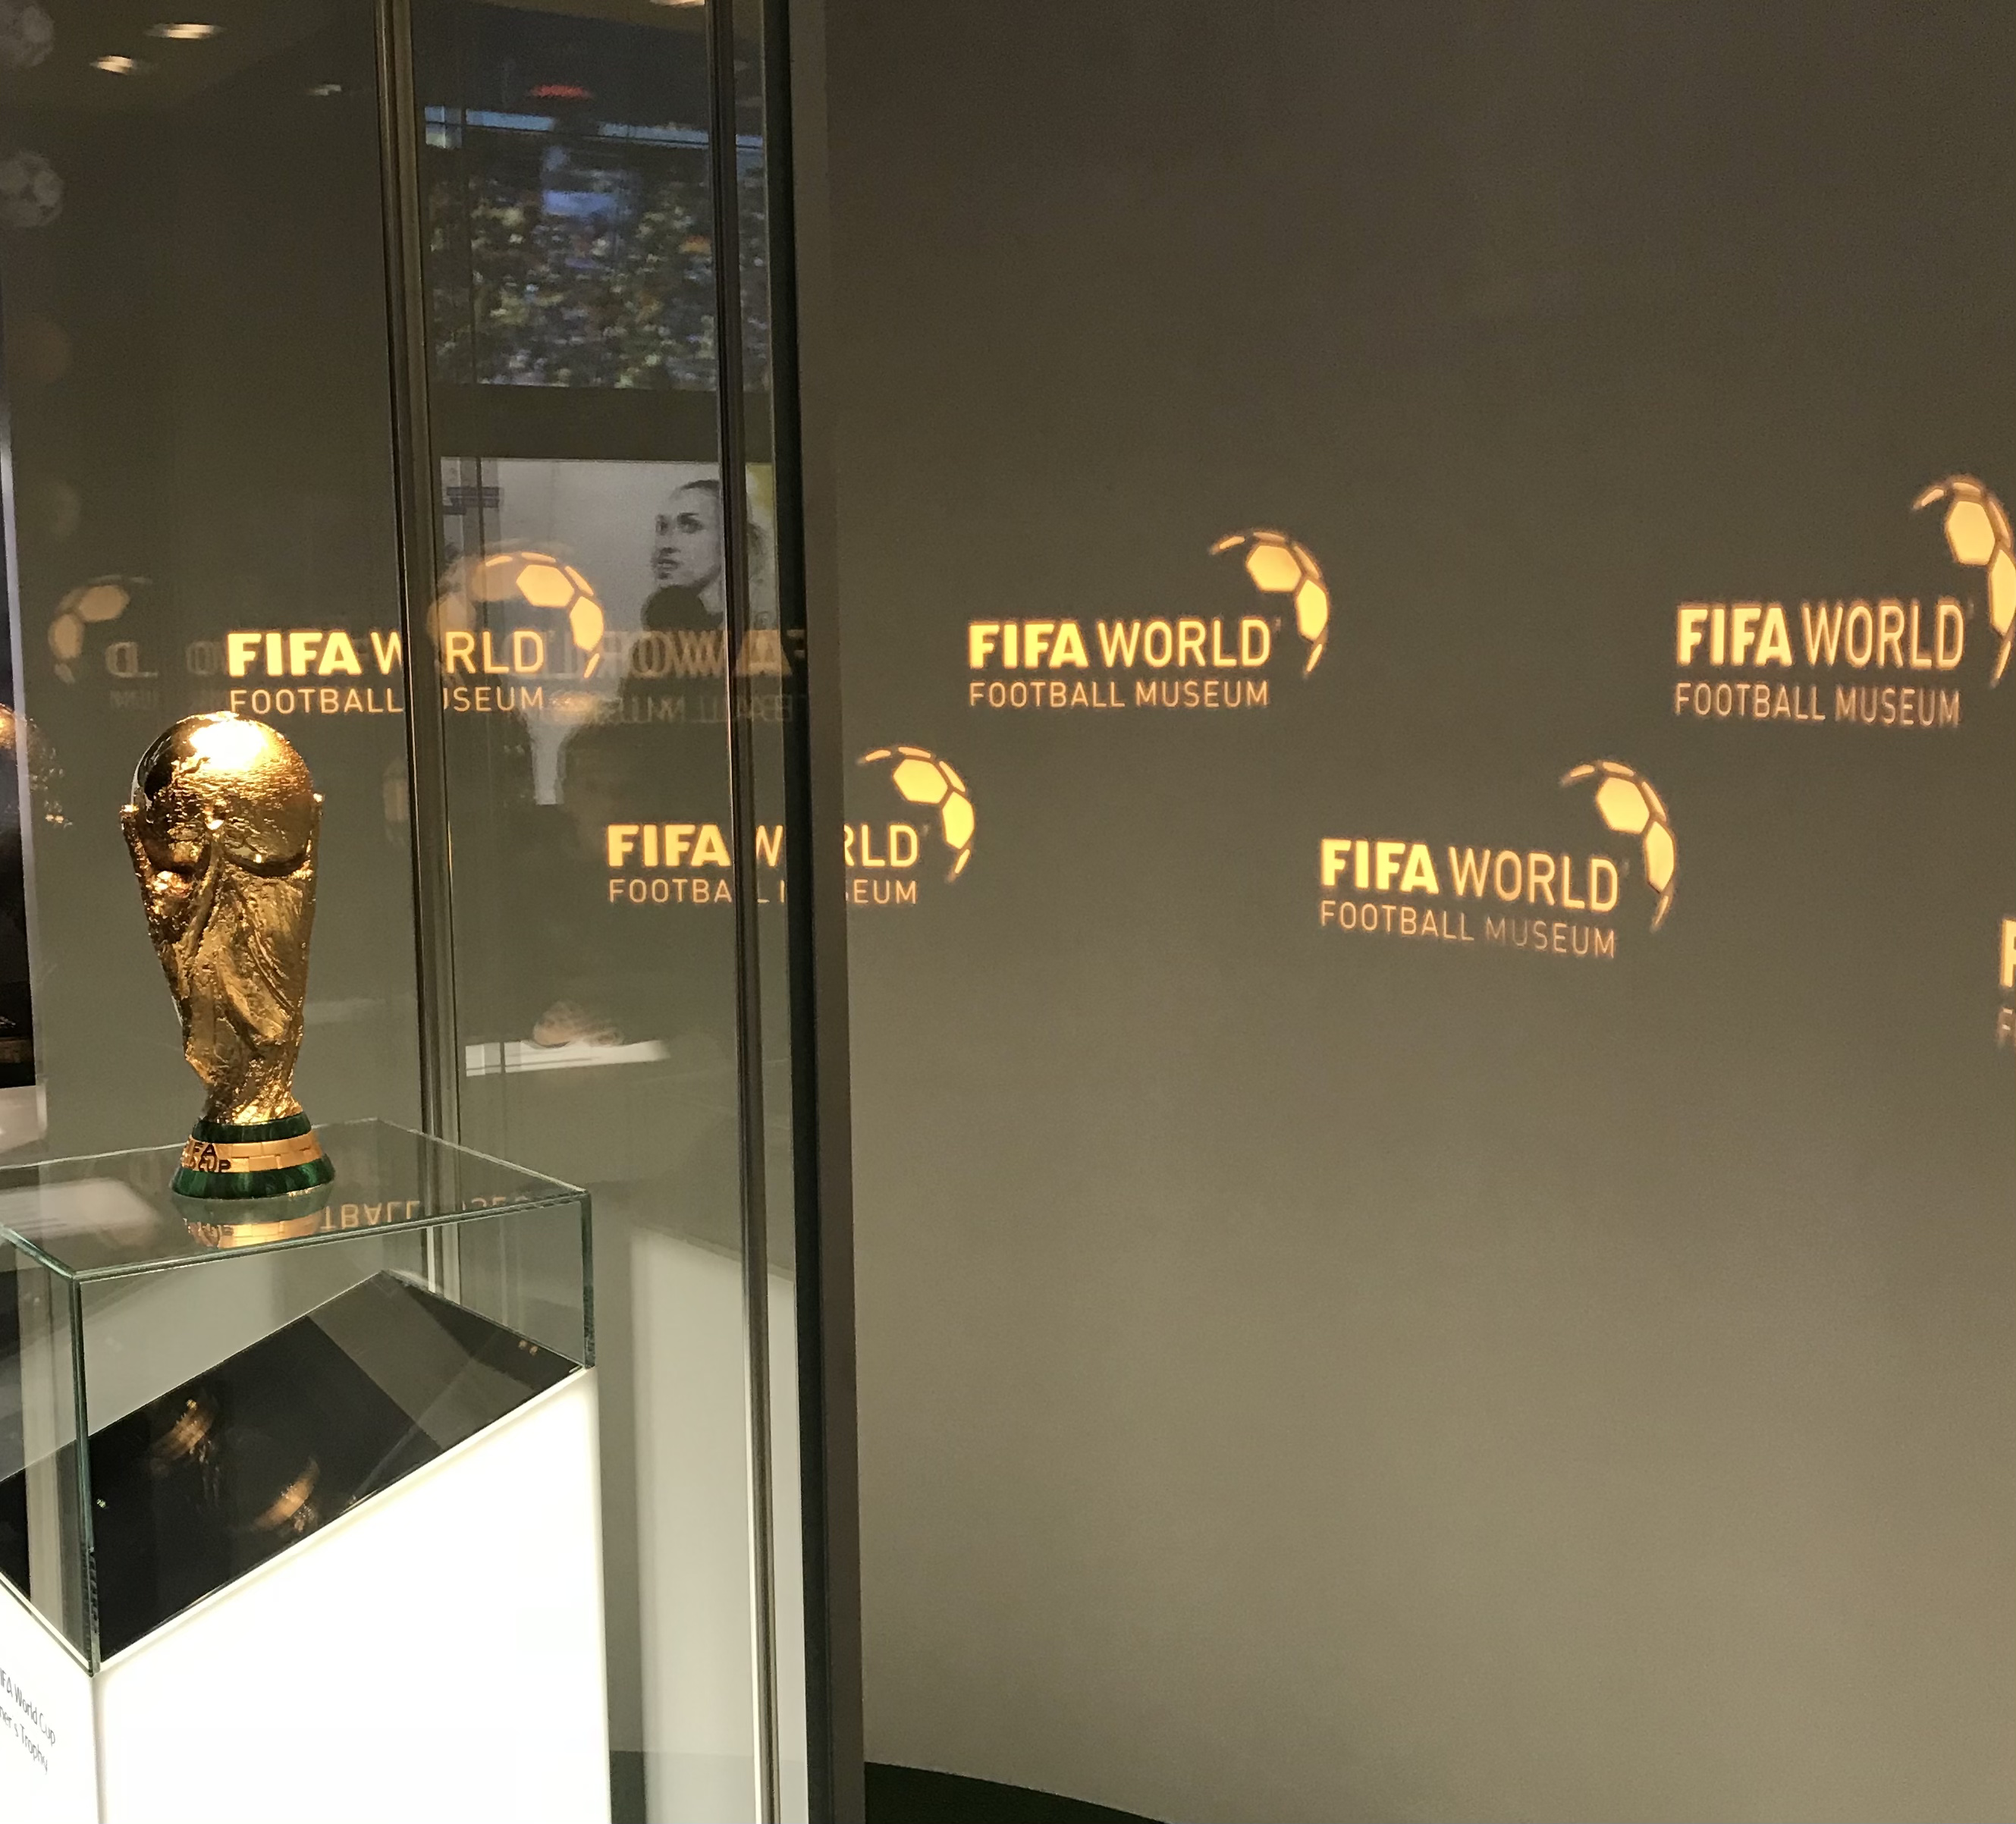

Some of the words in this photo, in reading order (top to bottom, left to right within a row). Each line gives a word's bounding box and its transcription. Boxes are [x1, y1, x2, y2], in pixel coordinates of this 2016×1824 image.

[227, 631, 363, 677] FIFA
[370, 630, 544, 675] WRLD
[969, 620, 1089, 669] FIFA
[1097, 617, 1271, 668] WORLD
[1677, 604, 1793, 667] FIFA
[1801, 601, 1964, 669] WORLD
[230, 687, 404, 714] FOOTBALL
[443, 686, 544, 713] SEUM
[969, 680, 1126, 708] FOOTBALL
[1135, 680, 1269, 708] MUSEUM
[1675, 682, 1826, 721] FOOTBALL
[1835, 686, 1960, 727] MUSEUM
[607, 824, 731, 867] FIFA
[755, 823, 919, 868] WLD
[609, 878, 770, 904] FOOTBA
[1320, 838, 1440, 896] FIFA
[1447, 846, 1619, 913] WORLD
[1320, 899, 1474, 942] FOOTBALL
[1484, 915, 1616, 959] MUSEUM
[0, 1667, 13, 1697] IFA
[14, 1683, 38, 1725] World
[39, 1712, 56, 1747] Cup
[20, 1723, 48, 1775] Trophy
